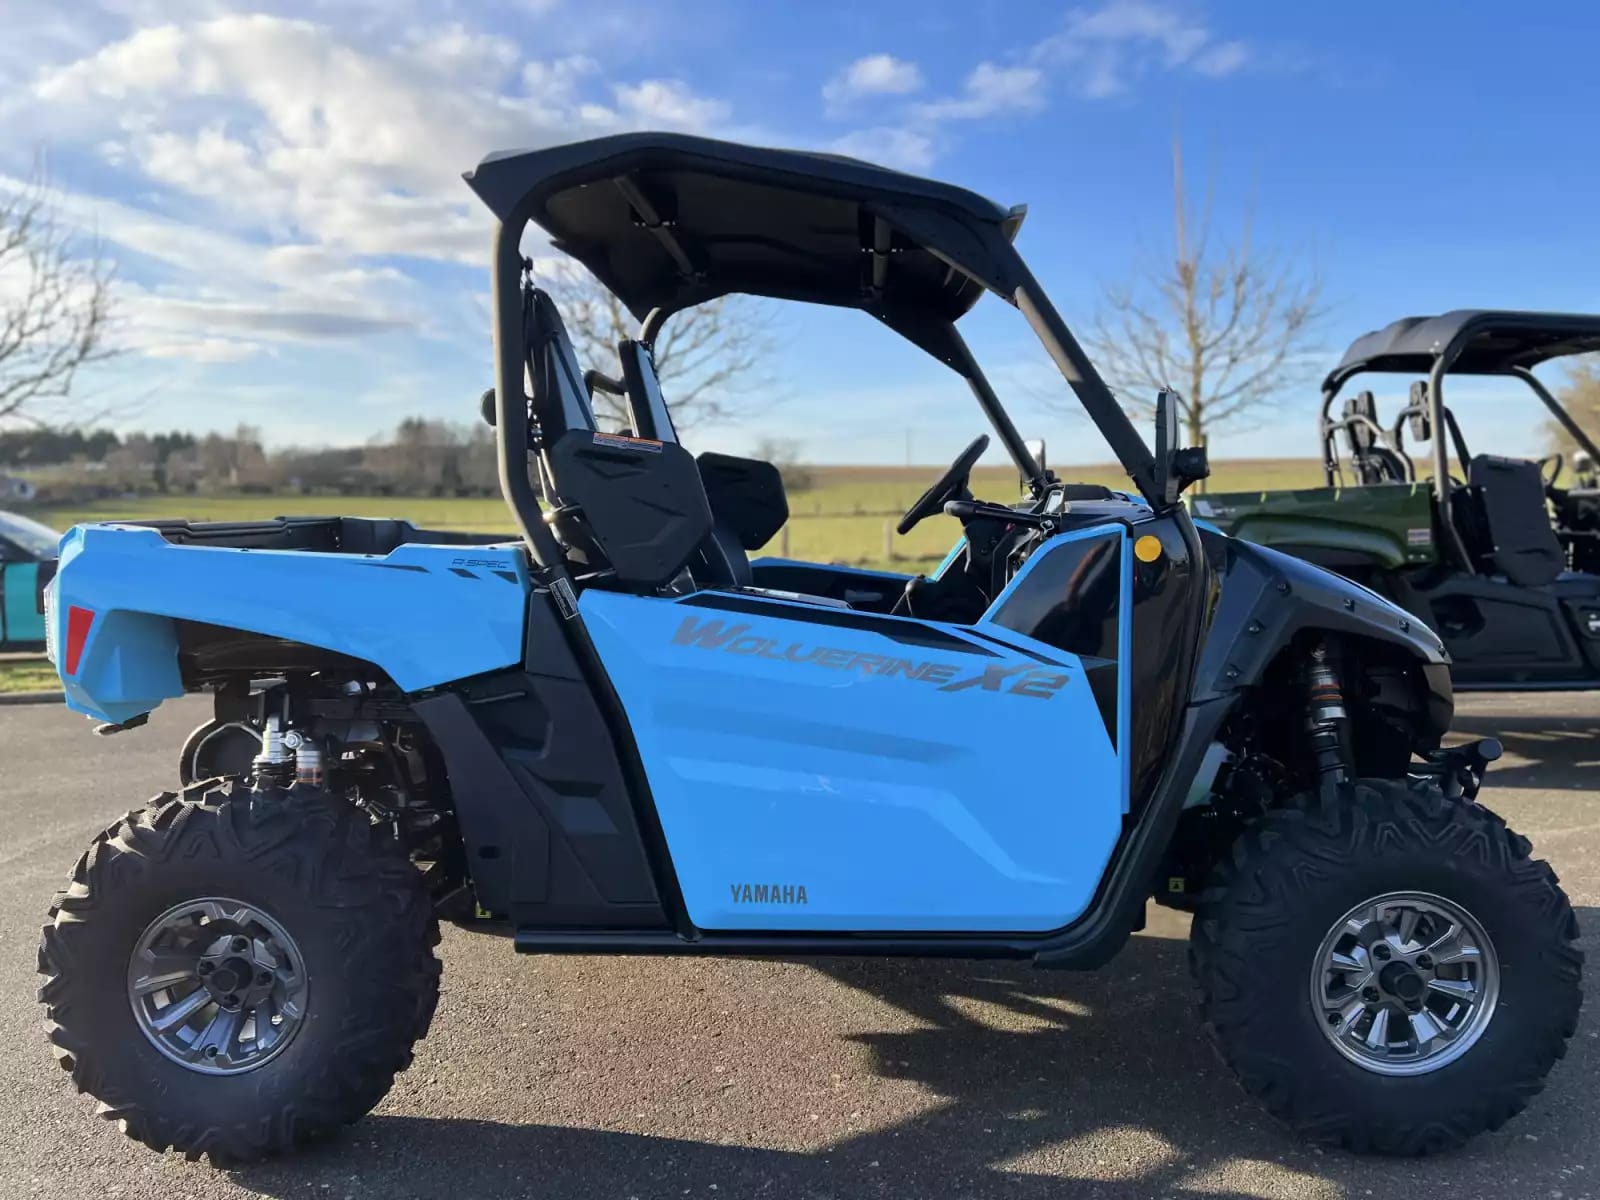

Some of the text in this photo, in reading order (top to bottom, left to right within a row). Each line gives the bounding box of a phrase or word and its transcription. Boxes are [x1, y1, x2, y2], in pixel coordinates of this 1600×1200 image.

[673, 616, 1070, 699] WOLVERINE X2
[730, 883, 808, 904] YAMAHA
